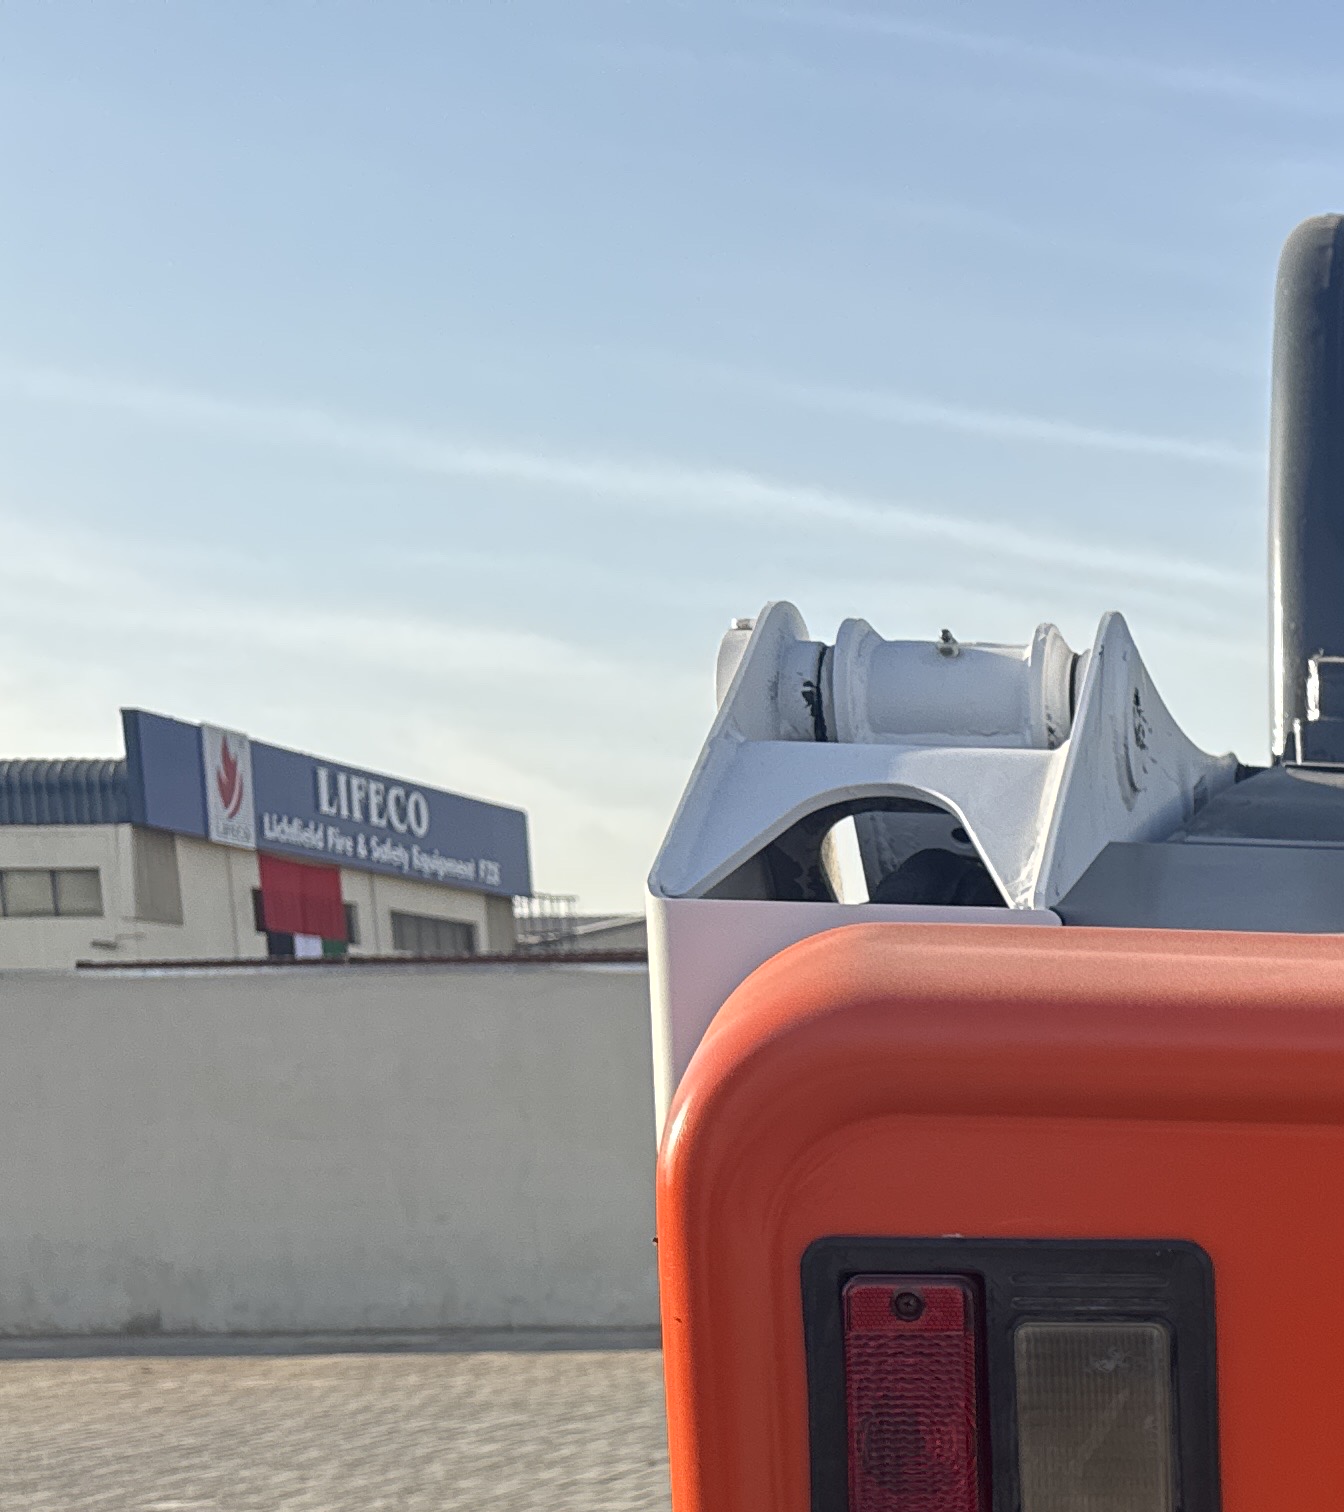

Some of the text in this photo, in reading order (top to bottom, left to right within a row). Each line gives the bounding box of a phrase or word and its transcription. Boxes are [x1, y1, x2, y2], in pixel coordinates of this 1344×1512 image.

[317, 766, 429, 838] LIFECO
[327, 826, 354, 857] Fire
[357, 833, 368, 859] &
[371, 836, 410, 873] Safety
